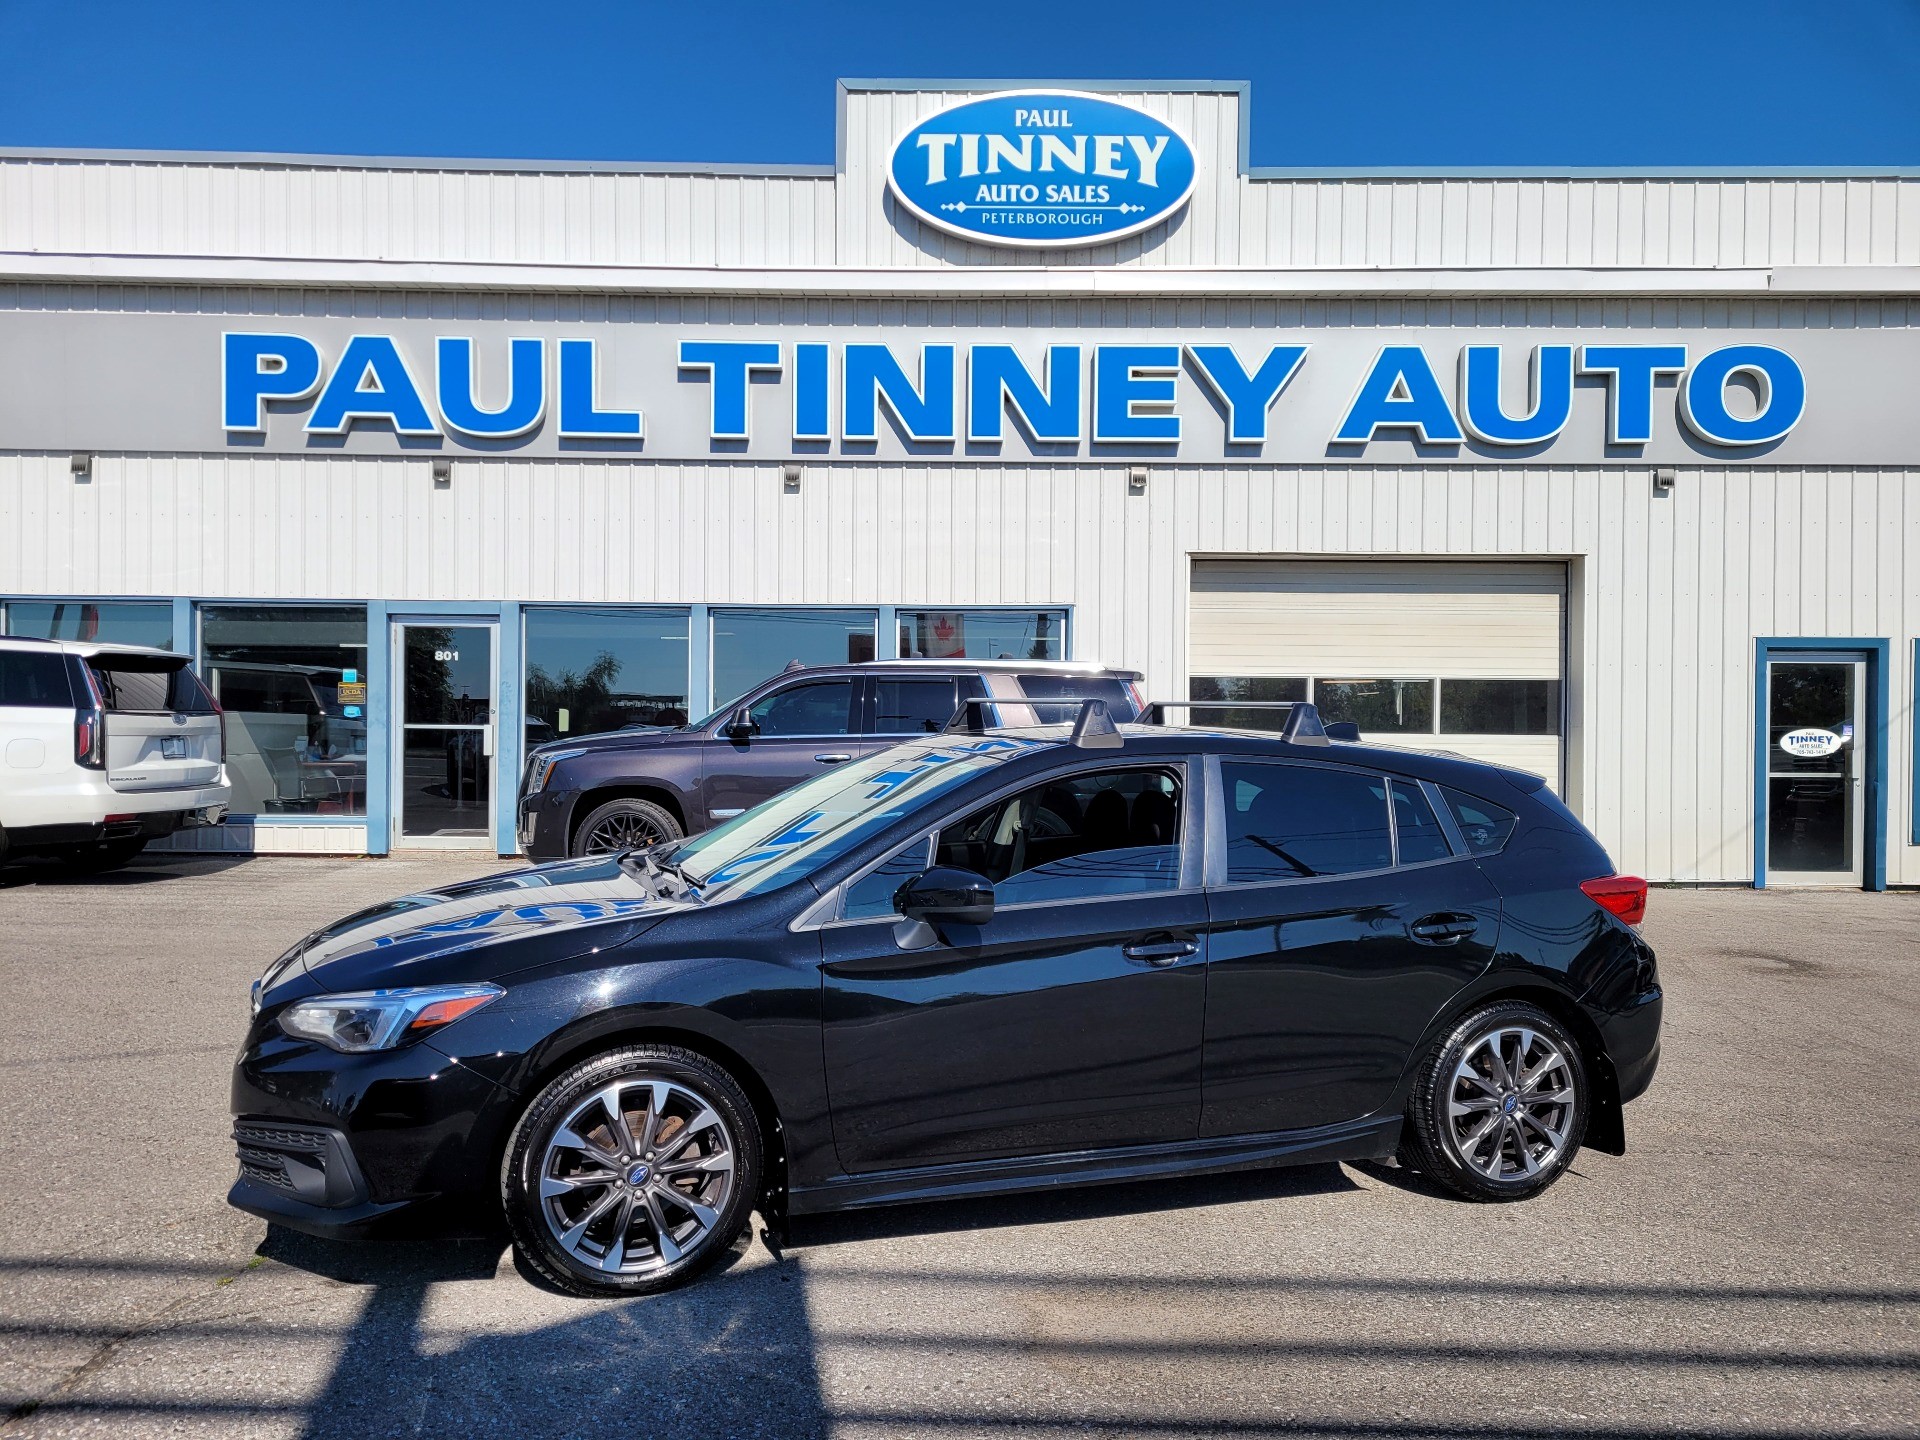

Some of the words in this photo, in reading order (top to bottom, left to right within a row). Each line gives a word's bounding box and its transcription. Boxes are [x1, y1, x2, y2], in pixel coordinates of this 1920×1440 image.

[1015, 109, 1073, 127] PAUL
[916, 133, 1170, 188] TINNEY
[975, 184, 1039, 203] AUTO
[1046, 184, 1110, 204] SALES
[982, 212, 1103, 225] PETERBOROUGH
[221, 331, 645, 439] PAUL
[677, 339, 1314, 444] TINNEY
[1331, 342, 1807, 447] AUTO
[434, 650, 459, 661] 801
[1788, 735, 1834, 746] TINNEY
